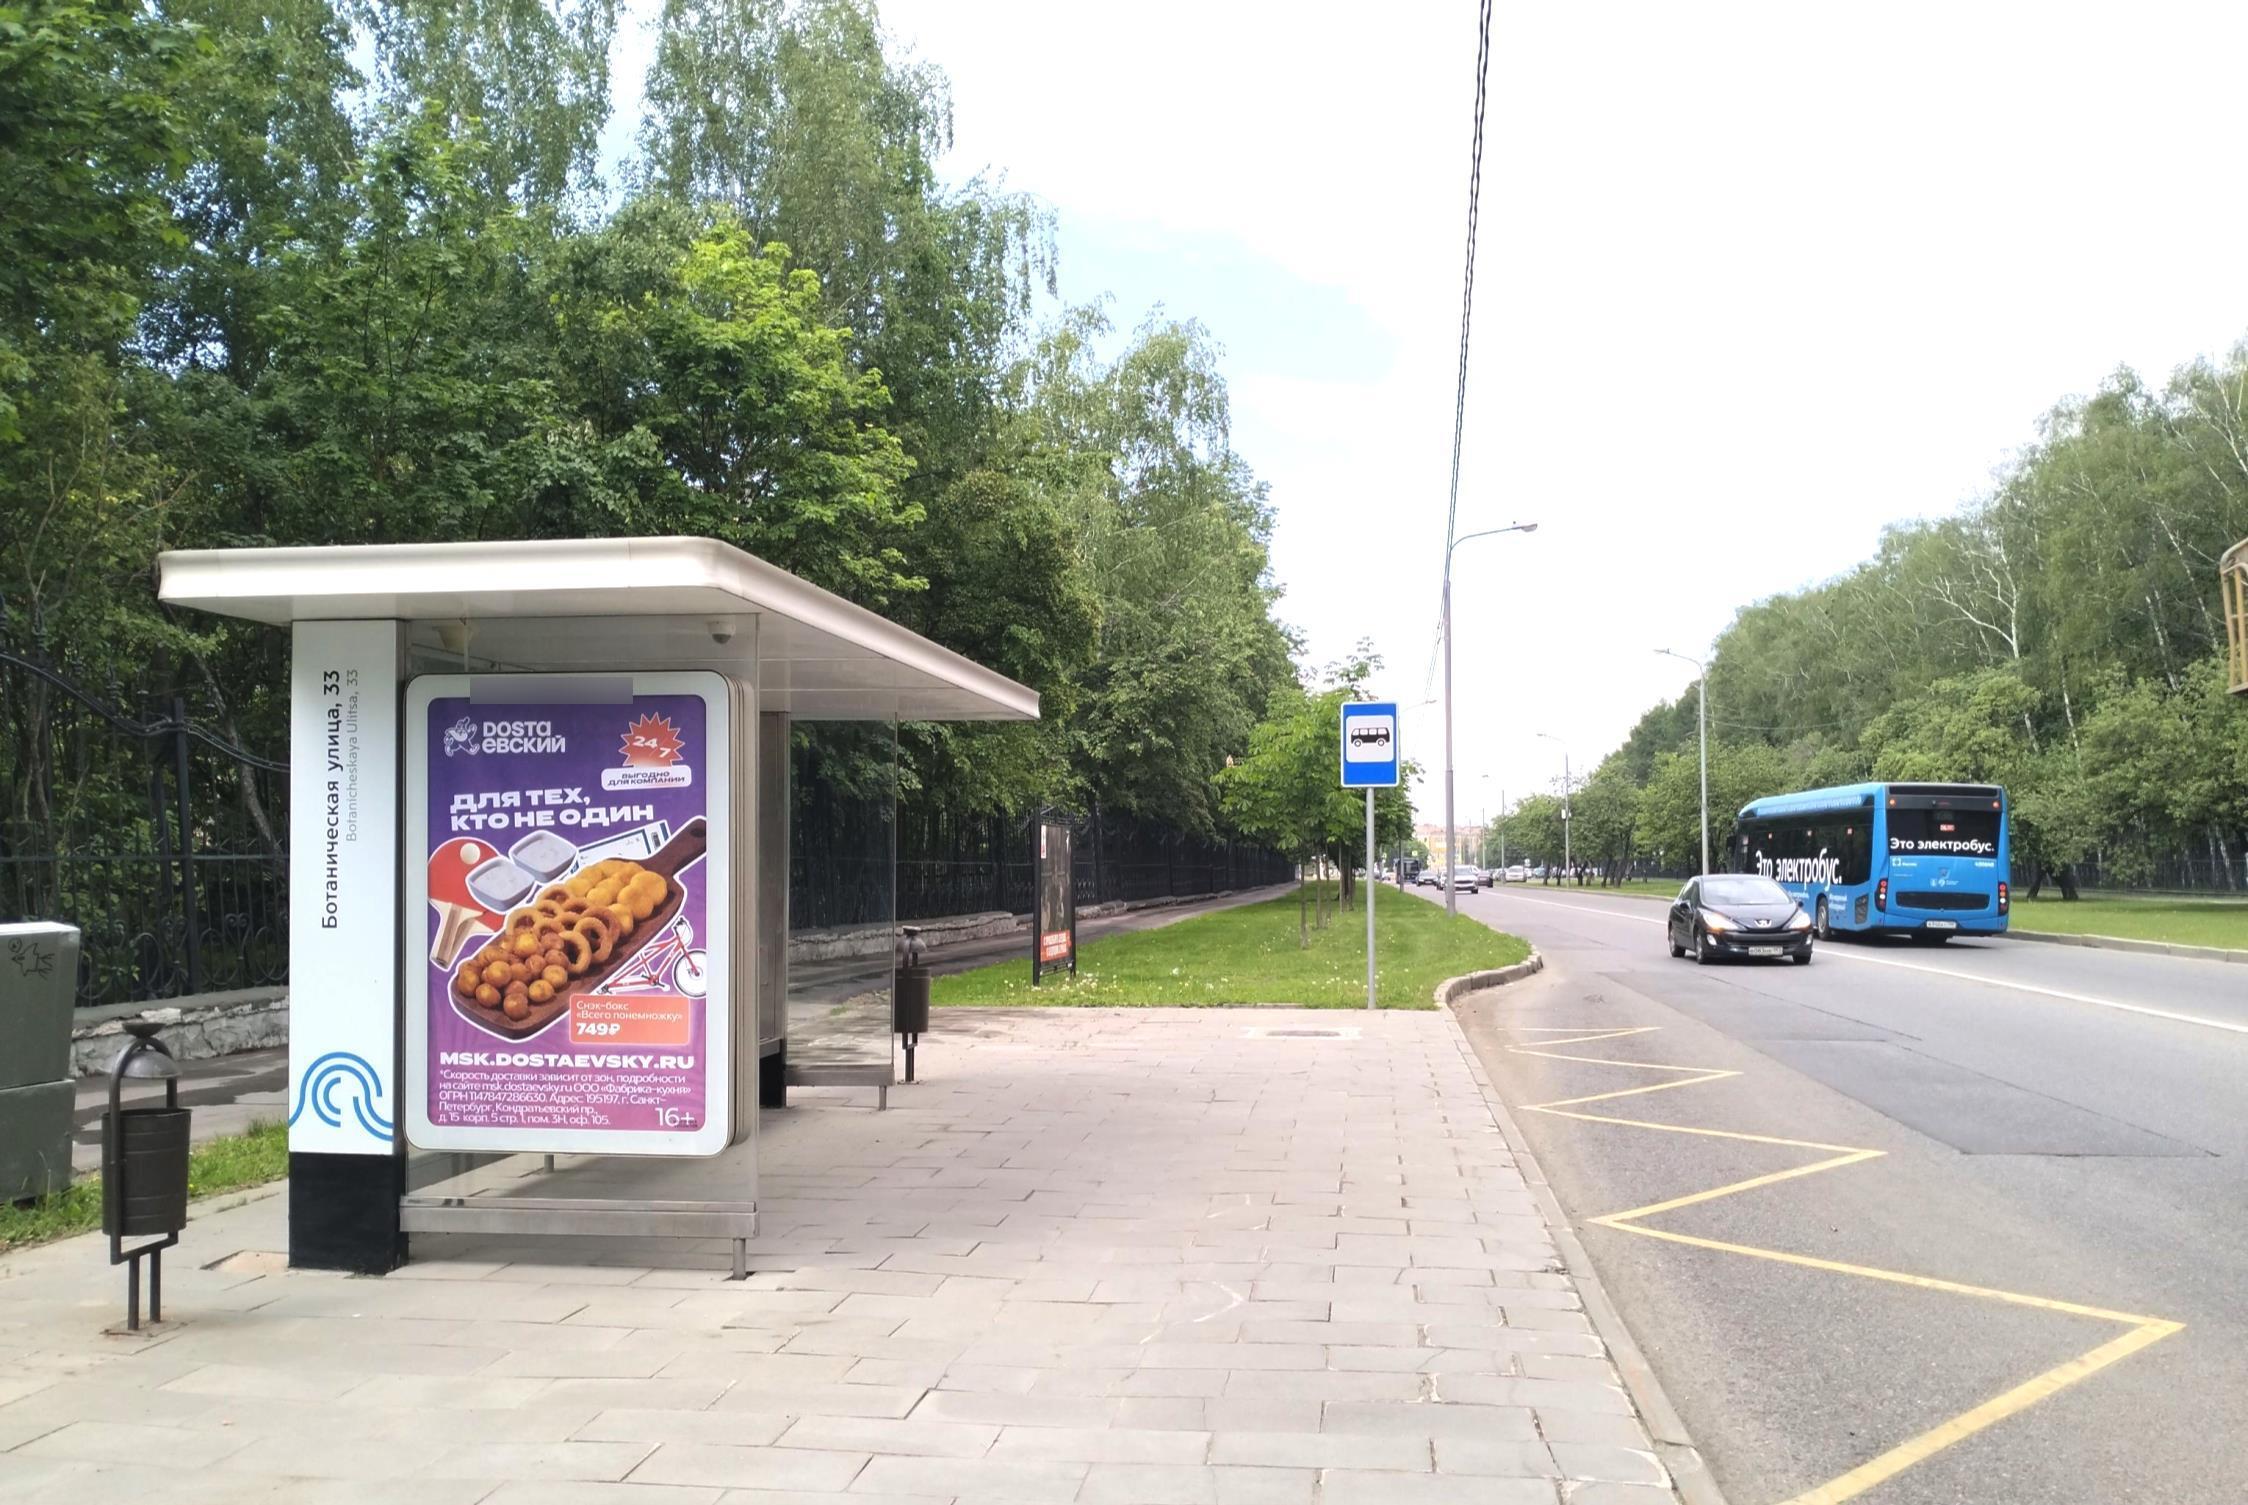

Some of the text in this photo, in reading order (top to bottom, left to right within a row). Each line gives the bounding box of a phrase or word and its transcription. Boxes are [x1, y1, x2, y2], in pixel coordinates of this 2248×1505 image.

[346, 669, 360, 842] Botanicheskaya Ulitsa, 33
[608, 777, 685, 787] ДЛЯ КОМПАНИИ
[622, 771, 670, 779] ВЫГОДНО
[321, 670, 343, 929] Ботаническая улица, 33
[450, 787, 591, 815] ДЛЯ ТЕХ,
[451, 804, 654, 832] КТО НЕ ОДИН
[1890, 837, 1995, 854] Это электробус.
[1755, 847, 1842, 892] Это электробус.
[576, 1000, 630, 1011] Снэк-бокс
[576, 1010, 683, 1023] «Всего понемножку»
[440, 1051, 694, 1070] MSK.DOSTAEVSKY.RU
[491, 1072, 537, 1082] доставки
[539, 1073, 579, 1082] зависит
[616, 1073, 686, 1085] подробности
[439, 1080, 691, 1096] на сайте msk.dostaevsky.ru ООО «Фабрика-кухня»
[439, 1090, 468, 1101] ОГРН
[630, 1095, 667, 1105] Санкт-
[491, 1112, 498, 1121] 5
[495, 1102, 579, 1115] Кондратьевский
[655, 1107, 695, 1127] 16+
